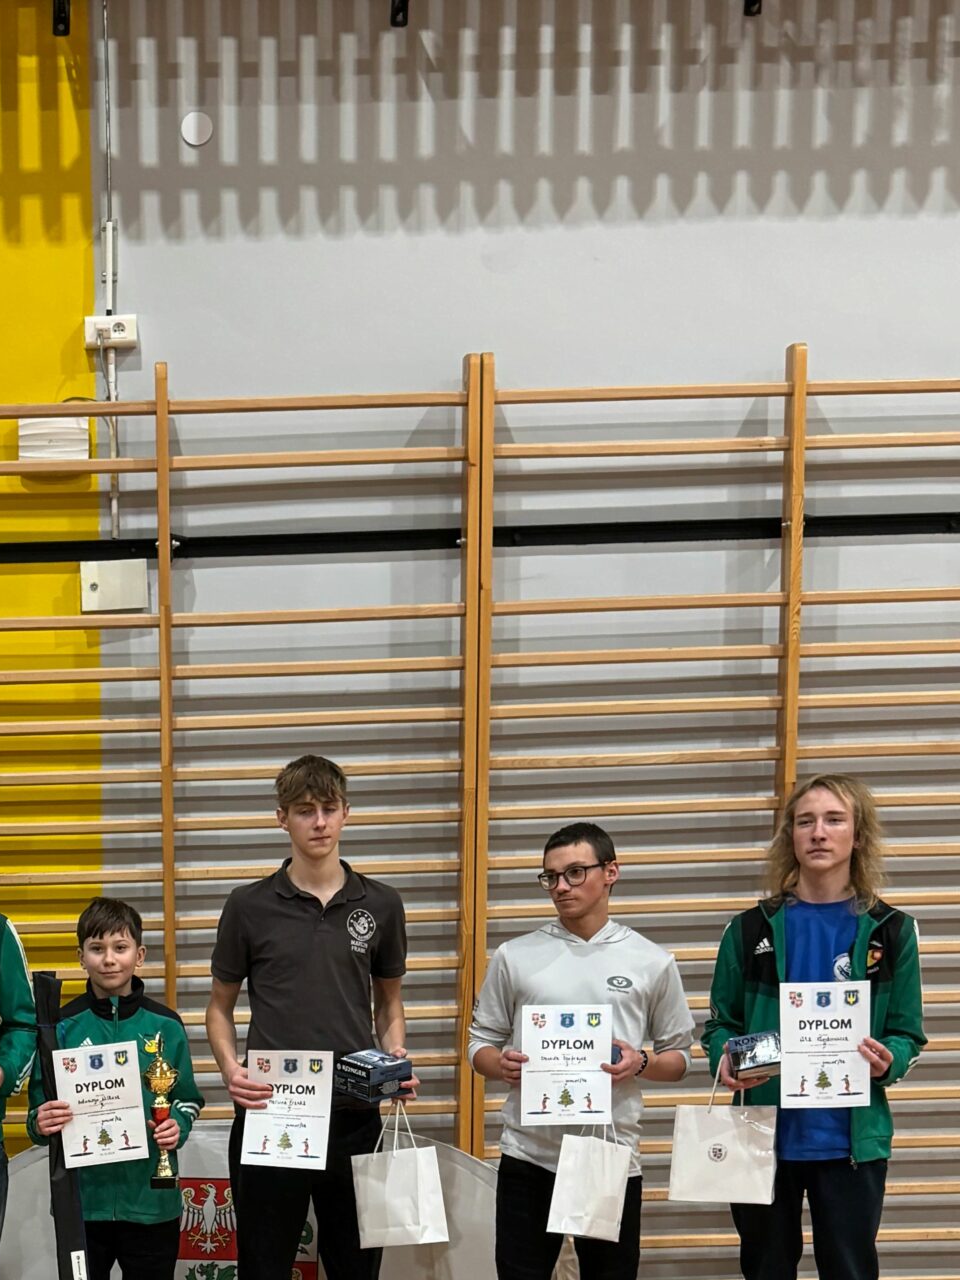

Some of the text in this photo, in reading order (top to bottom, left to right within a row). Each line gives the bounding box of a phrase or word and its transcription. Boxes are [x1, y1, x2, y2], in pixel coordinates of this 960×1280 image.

[799, 1019, 852, 1030] DYPLOM
[541, 1039, 594, 1050] DYPLOM
[75, 1077, 125, 1094] DYPLOM
